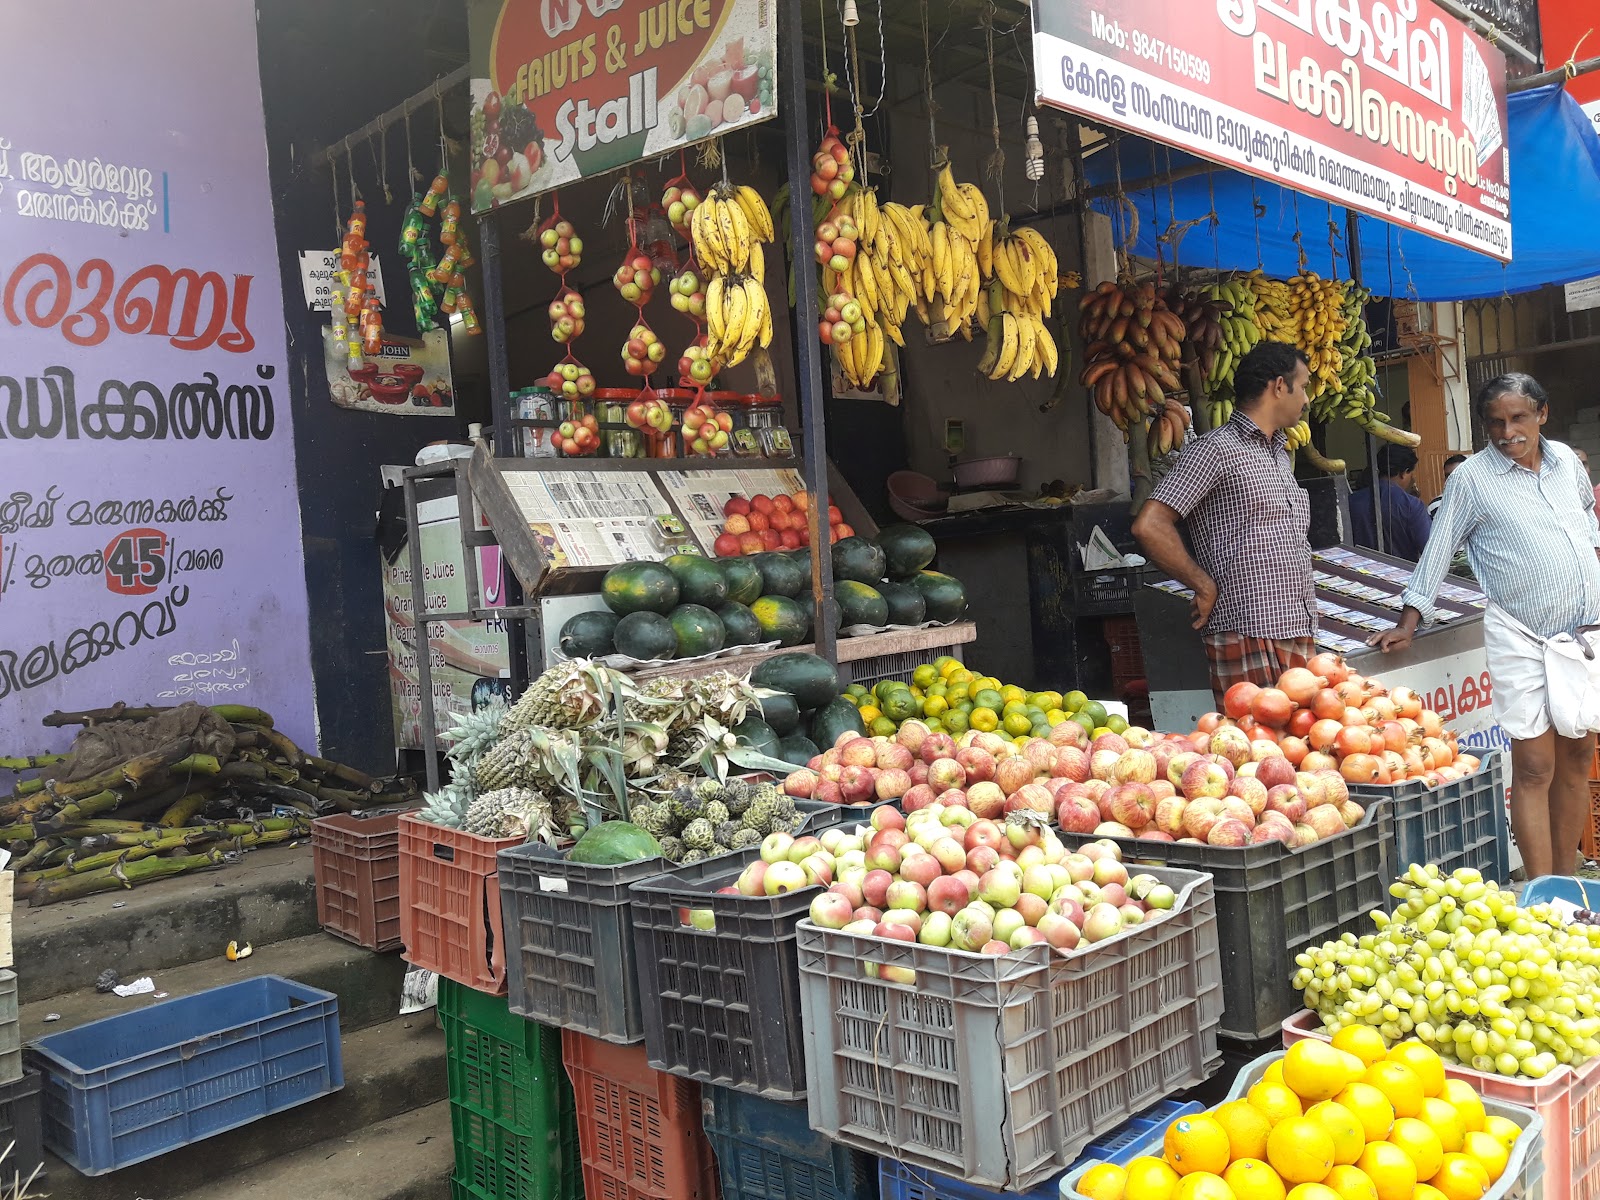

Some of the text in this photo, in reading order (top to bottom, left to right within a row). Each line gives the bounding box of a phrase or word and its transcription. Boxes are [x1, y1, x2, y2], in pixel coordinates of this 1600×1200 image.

[515, 33, 597, 105] FRIUTS
[605, 24, 628, 74] &
[635, 0, 711, 56] JUICE
[1090, 10, 1211, 85] Mob: 9847150599
[554, 66, 659, 163] Stall
[1061, 55, 1127, 117] കേരള
[1131, 81, 1213, 140] സംസ്ഥാന
[383, 346, 408, 355] JOHN
[432, 561, 455, 580] Juice
